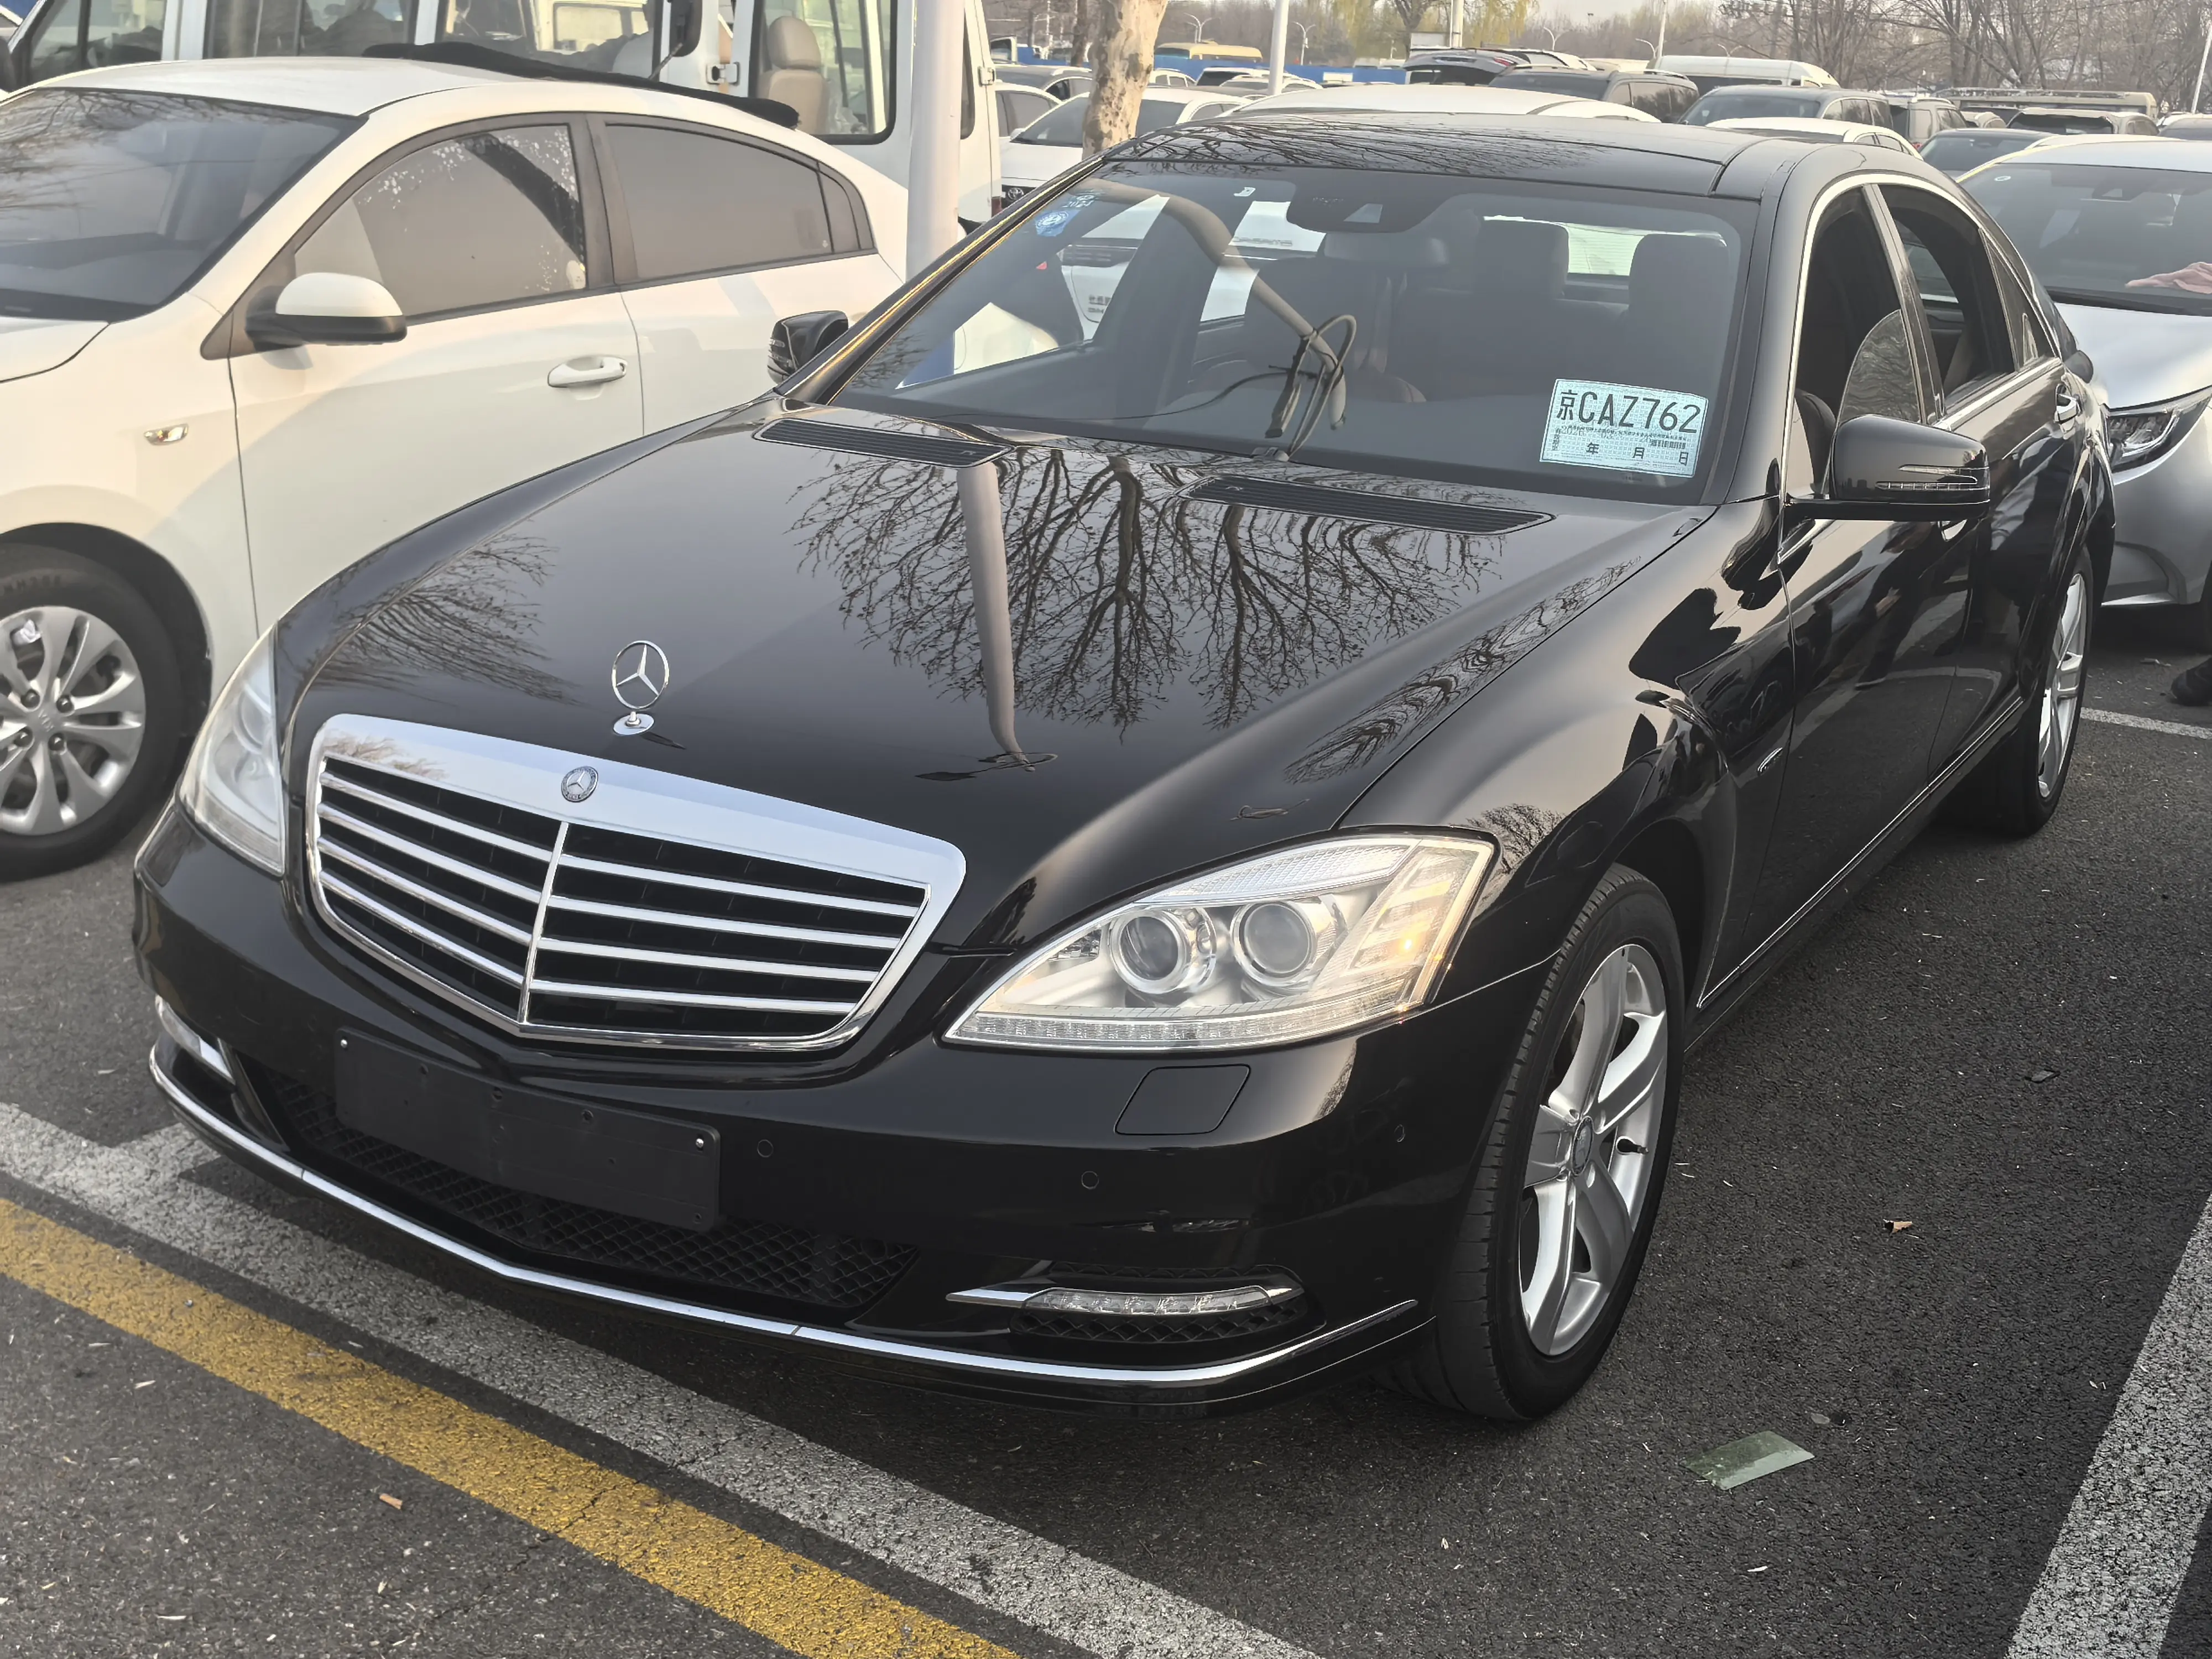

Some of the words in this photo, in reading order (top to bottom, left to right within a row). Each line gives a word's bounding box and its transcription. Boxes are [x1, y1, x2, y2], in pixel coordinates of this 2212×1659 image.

[1556, 389, 1702, 434] 京CAZ762
[1586, 442, 1600, 455] 年
[1632, 447, 1645, 460] 月
[1678, 451, 1689, 466] 日
